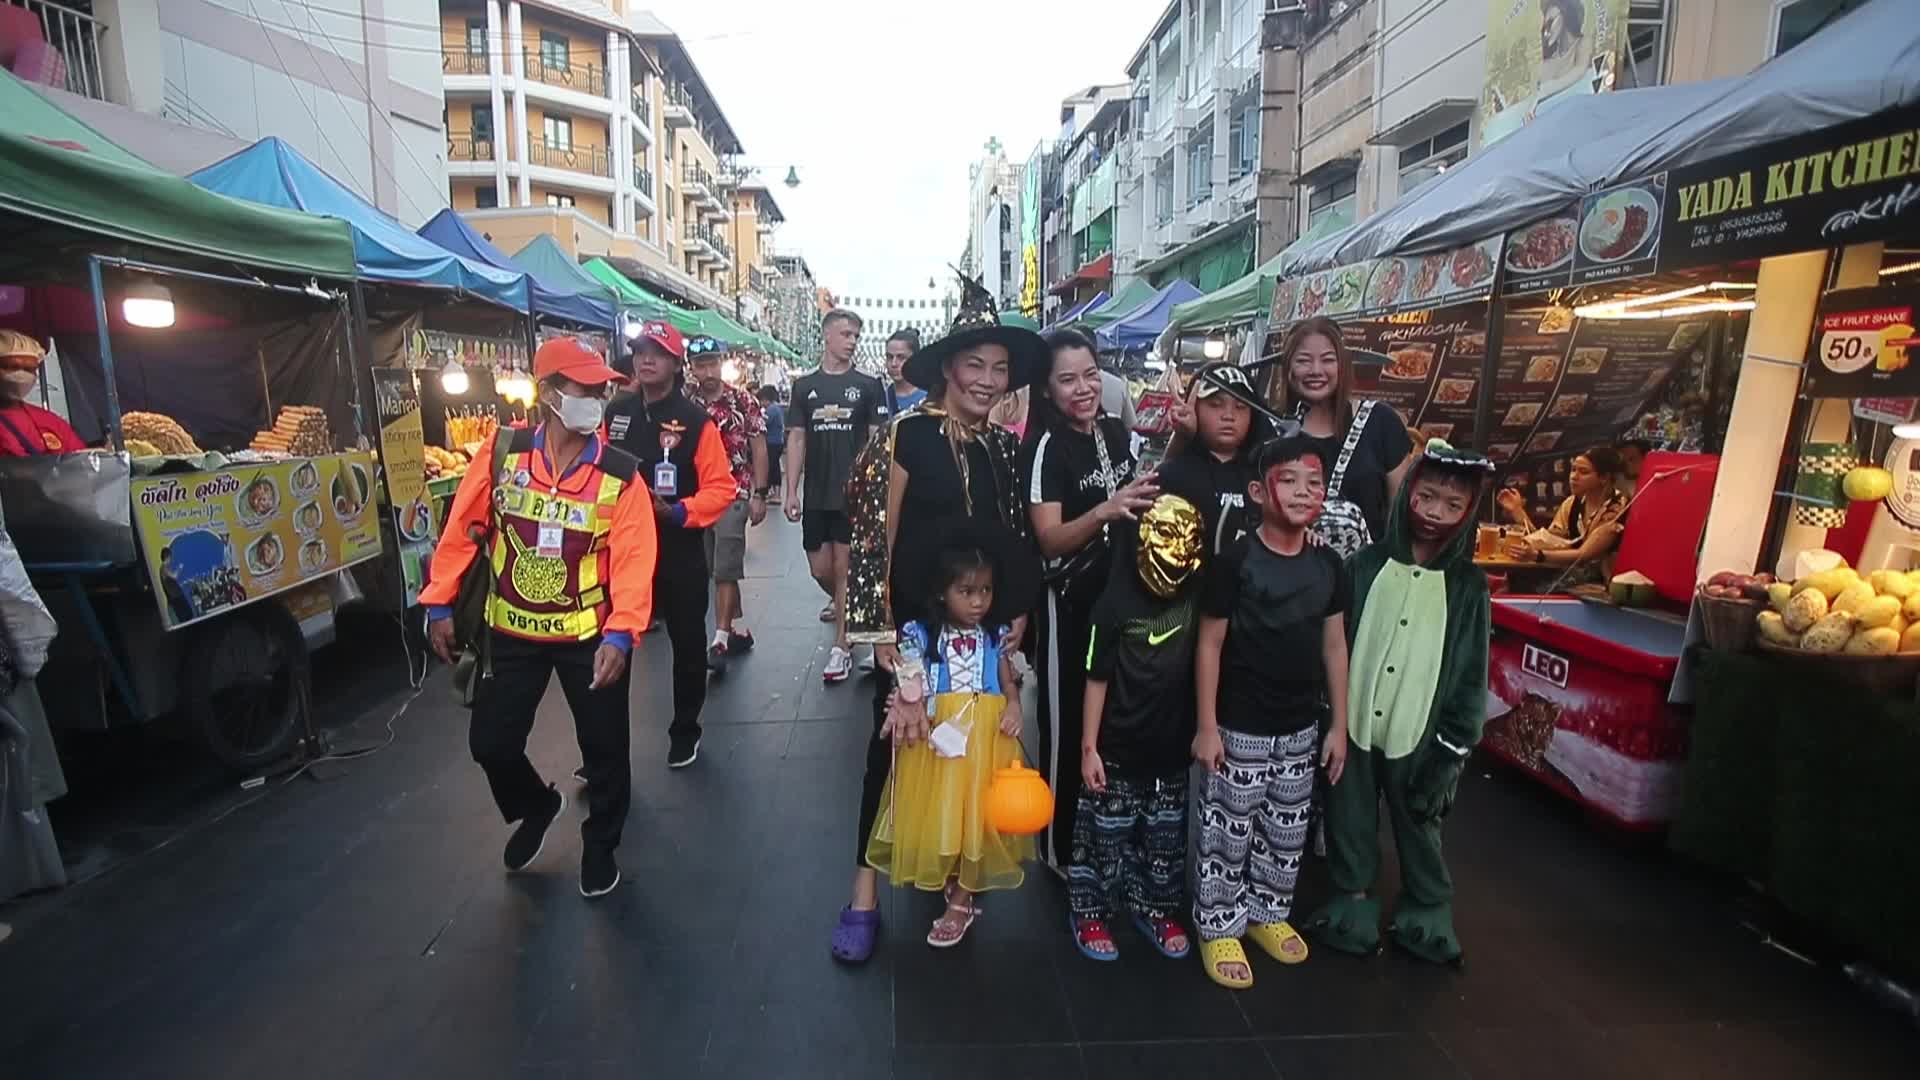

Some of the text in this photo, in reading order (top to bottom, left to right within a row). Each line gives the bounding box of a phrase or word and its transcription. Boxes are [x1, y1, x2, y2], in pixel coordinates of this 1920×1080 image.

[1678, 171, 1752, 222] YADA
[1824, 311, 1908, 328] ICE FRUIT SHAKE
[1828, 336, 1862, 361] 50
[507, 608, 565, 635] จราจร
[1525, 648, 1567, 684] LEO
